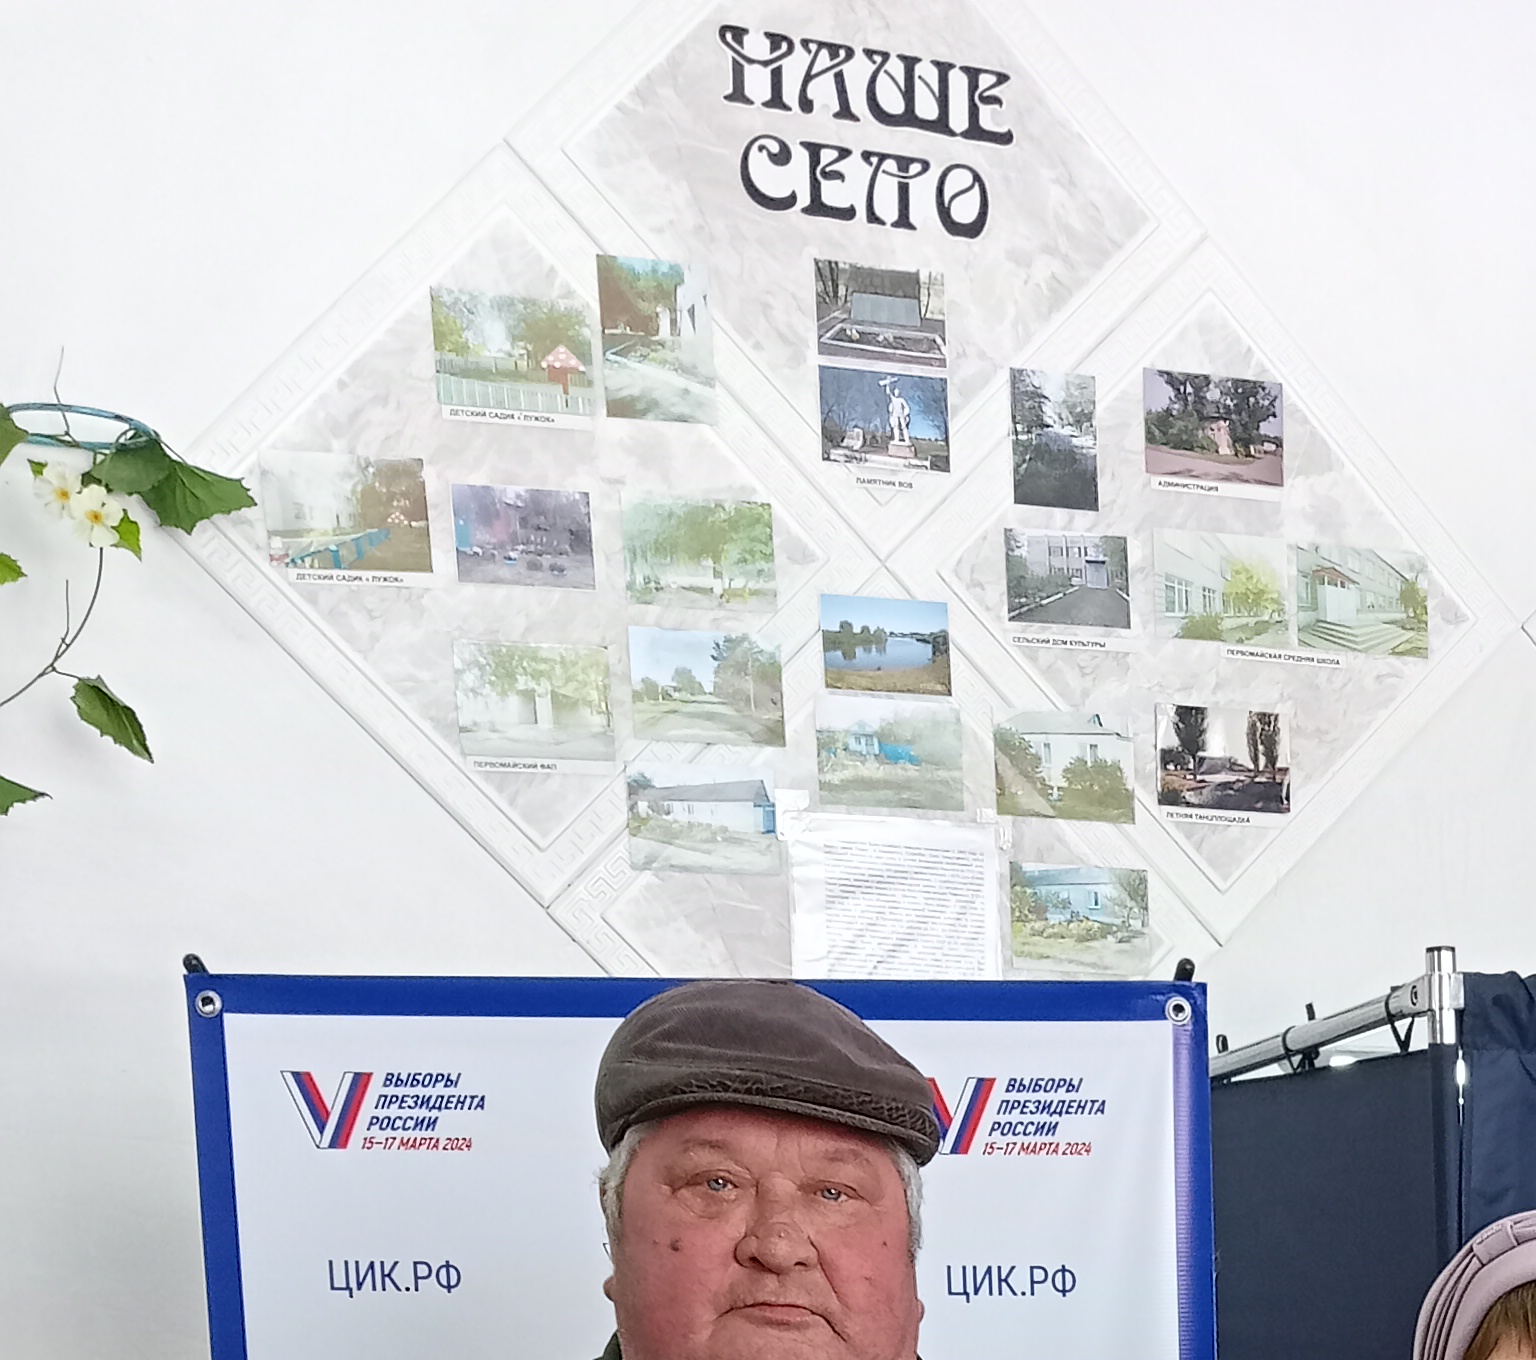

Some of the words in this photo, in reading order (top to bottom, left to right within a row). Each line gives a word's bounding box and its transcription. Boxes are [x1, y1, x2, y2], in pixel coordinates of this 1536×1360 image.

[718, 24, 1014, 146] НАШЕ
[740, 134, 989, 239] СЕЛО
[1157, 480, 1219, 493] АДМИНИСТРАЦИЯ
[295, 572, 334, 582] ДЕТСКИЙ
[1012, 635, 1050, 644] СЕЛЬСКИЙ
[1226, 648, 1282, 660] ПЕРВОМАЙСКАЯ
[1283, 653, 1315, 663] СРЕДНЯЯ
[1316, 657, 1341, 666] ШКОЛА
[473, 760, 538, 770] ПЕРВОМАЙСКИЙ
[382, 1072, 462, 1088] ВЫБОРЫ
[1004, 1077, 1084, 1094] ВЫБОРЫ
[374, 1094, 486, 1112] ПРЕЗИДЕНТА
[996, 1099, 1107, 1118] ПРЕЗИДЕНТА
[366, 1115, 440, 1132] РОССИИ
[988, 1121, 1060, 1137] РОССИИ
[397, 1136, 440, 1151] МАРТА
[442, 1137, 473, 1151] 2024
[1017, 1141, 1060, 1156] МАРТА
[1061, 1141, 1092, 1156] 2024
[328, 1259, 462, 1299] ЦИК.РФ
[946, 1264, 1077, 1304] ЦИК.РФ
